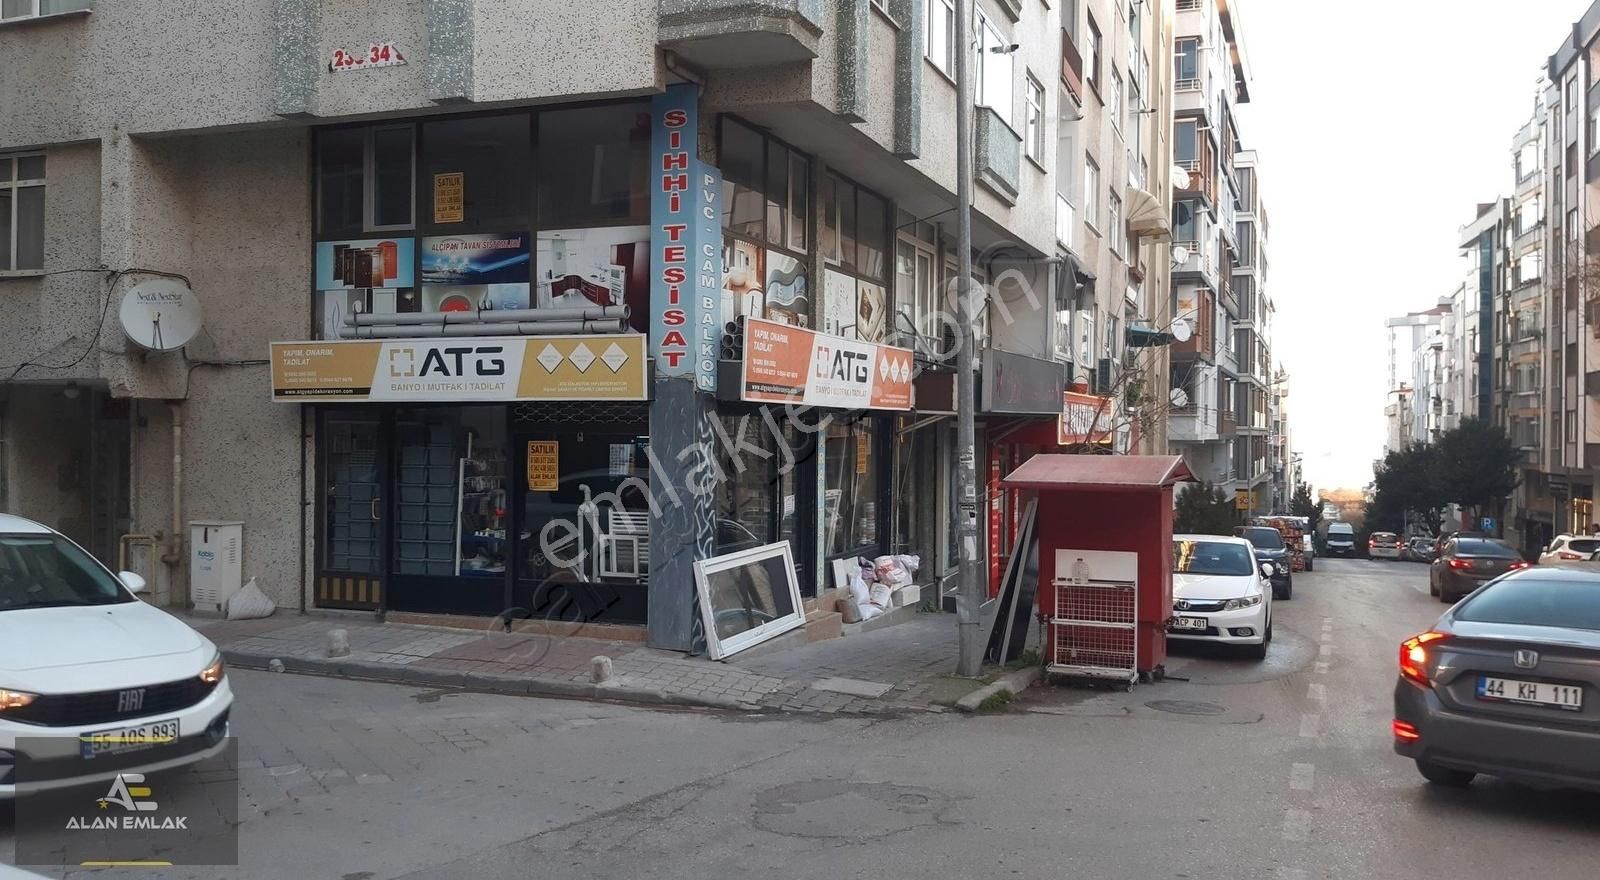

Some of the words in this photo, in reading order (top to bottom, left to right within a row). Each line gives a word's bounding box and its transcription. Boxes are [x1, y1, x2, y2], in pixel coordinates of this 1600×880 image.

[703, 173, 715, 219] PVC
[460, 242, 480, 250] TAVAN
[701, 244, 715, 289] CAM
[661, 224, 688, 368] TESİSAT
[701, 297, 714, 388] BALKON
[419, 346, 505, 376] ATG
[830, 349, 868, 383] ATG
[391, 383, 420, 391] BANYO
[428, 383, 462, 391] MUTFAK
[530, 444, 556, 454] SATILIK
[1192, 618, 1206, 628] 401
[118, 689, 146, 712] FIAT
[1487, 680, 1505, 696] 44
[1518, 683, 1537, 700] KH
[1552, 686, 1579, 705] 111
[152, 723, 177, 741] 893
